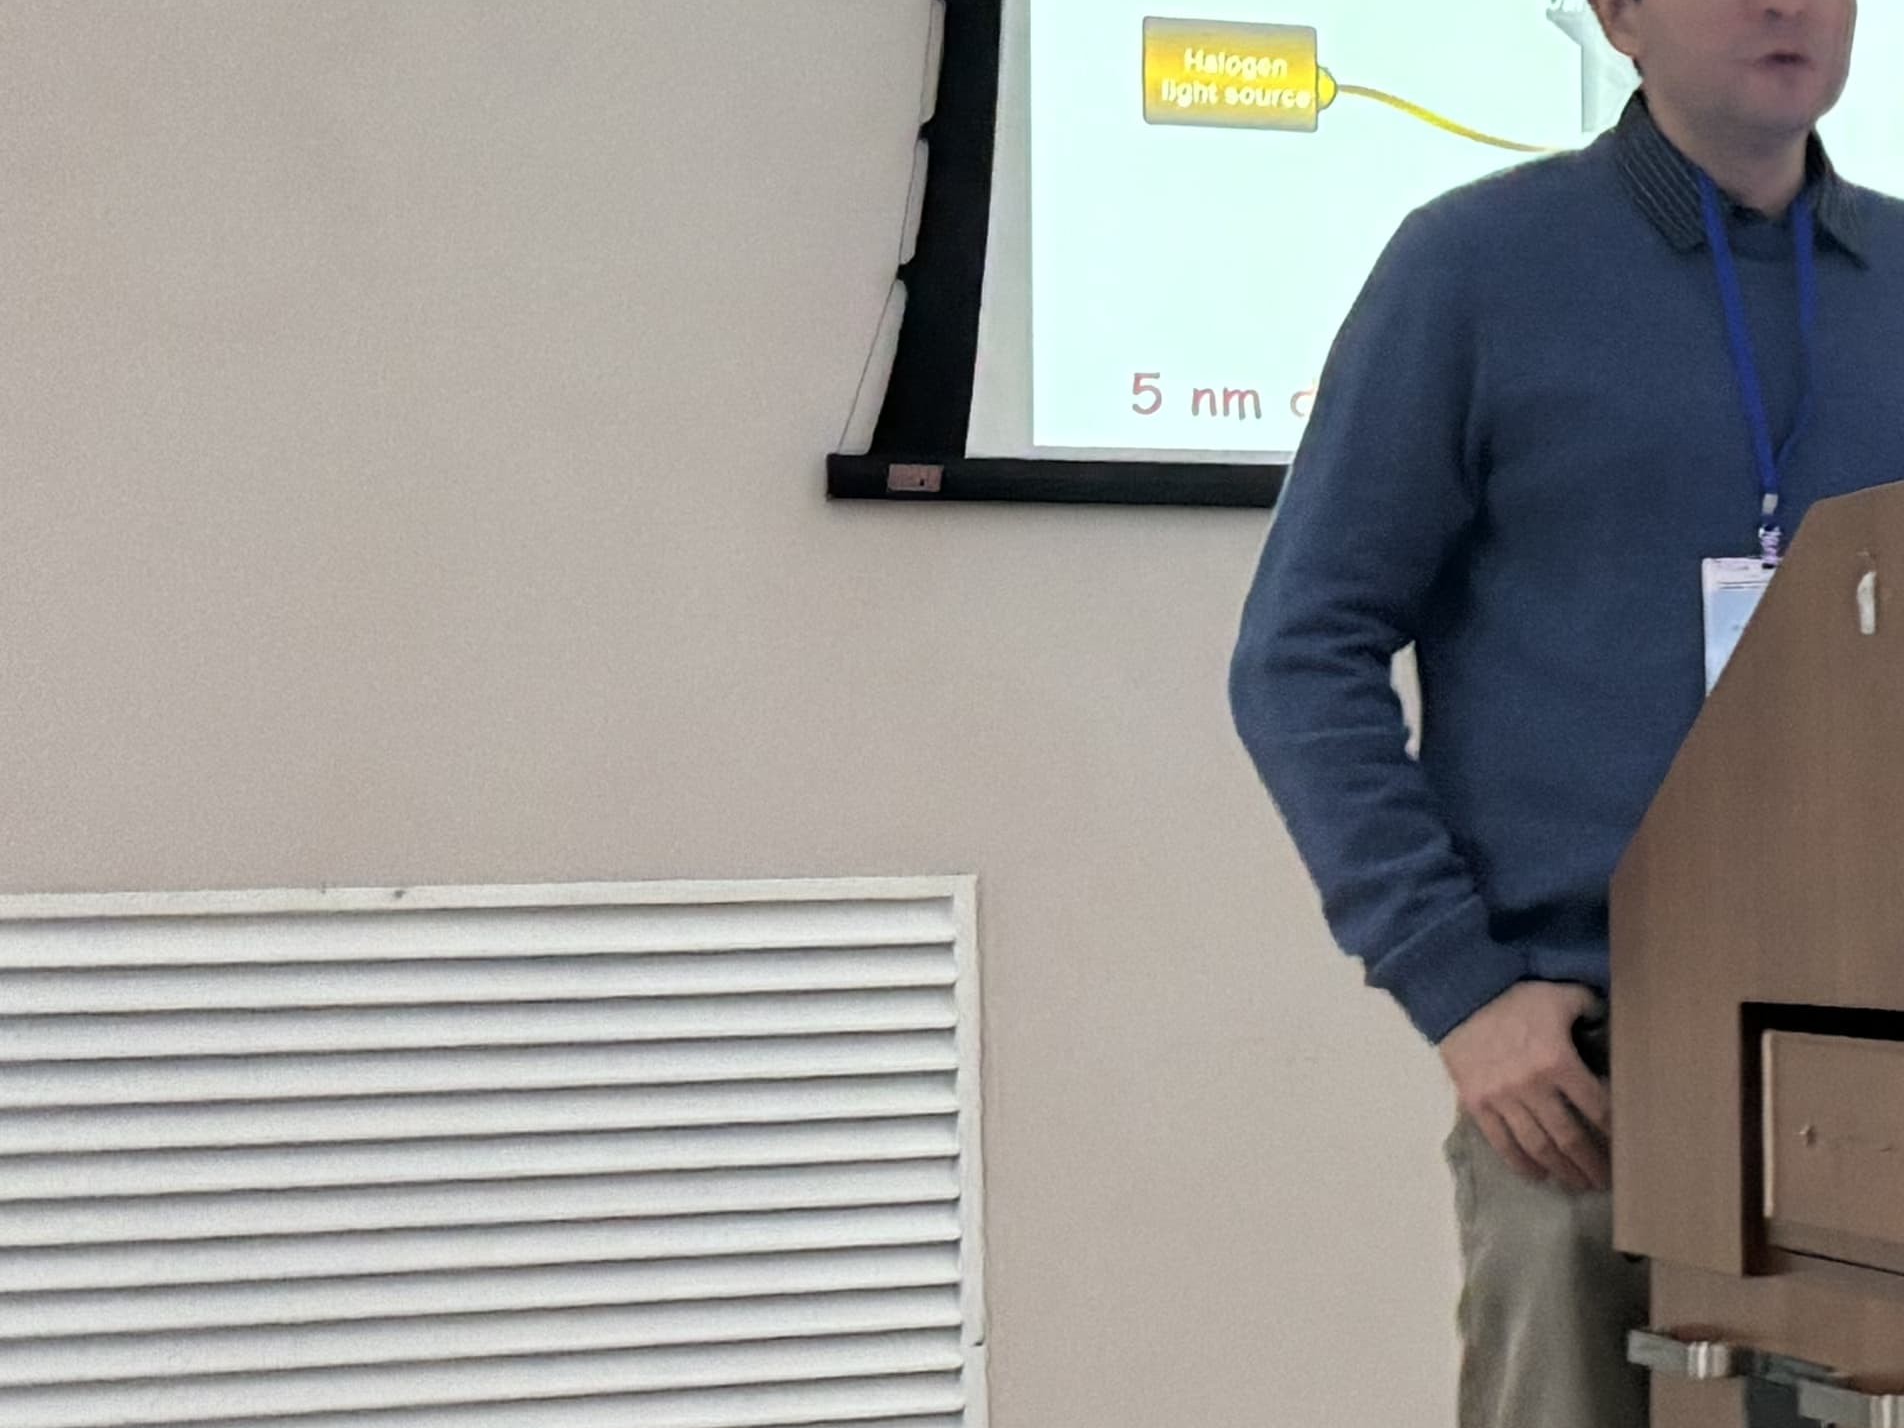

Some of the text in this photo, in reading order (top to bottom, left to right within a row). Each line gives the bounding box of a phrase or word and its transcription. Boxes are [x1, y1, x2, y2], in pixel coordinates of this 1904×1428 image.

[1184, 47, 1288, 81] Halogen
[1162, 78, 1311, 109] light source
[1130, 371, 1163, 416] 5
[1191, 380, 1262, 421] nm
